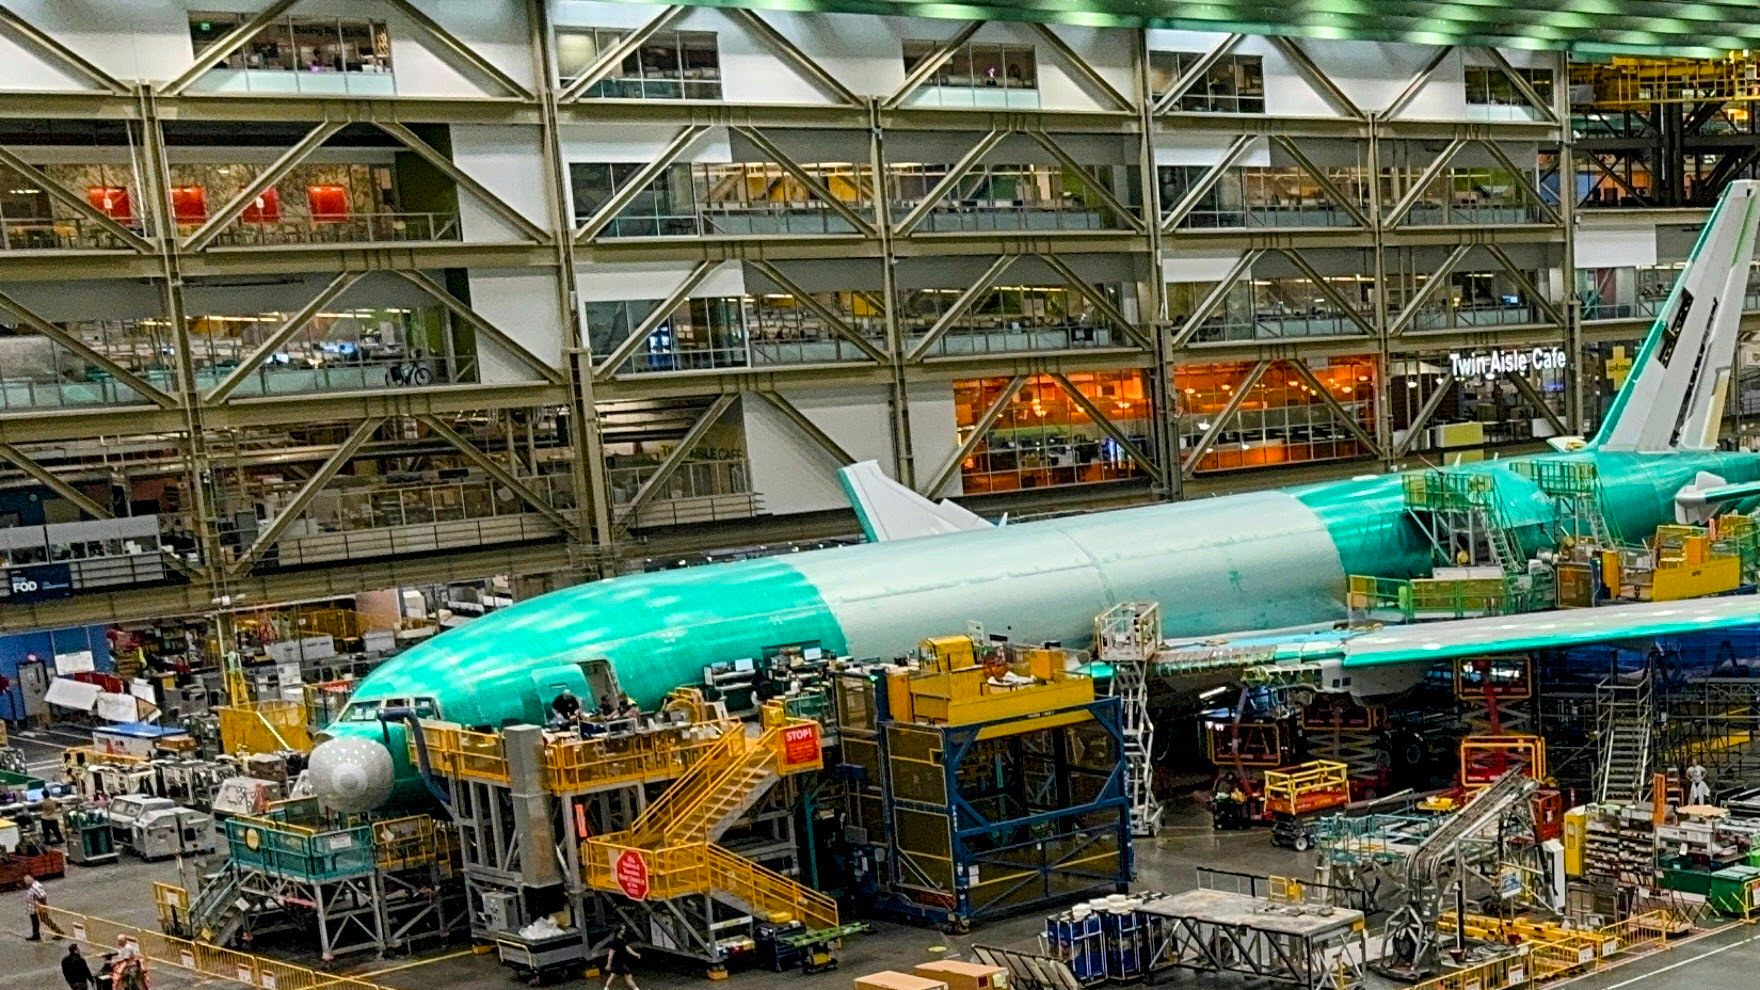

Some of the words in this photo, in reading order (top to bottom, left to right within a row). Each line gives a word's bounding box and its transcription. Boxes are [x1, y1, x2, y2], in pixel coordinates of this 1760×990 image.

[1449, 353, 1486, 376] Twin
[1490, 350, 1528, 373] Aisle
[1533, 347, 1566, 370] Cafe
[12, 580, 38, 594] FOD
[786, 727, 813, 742] STOP!
